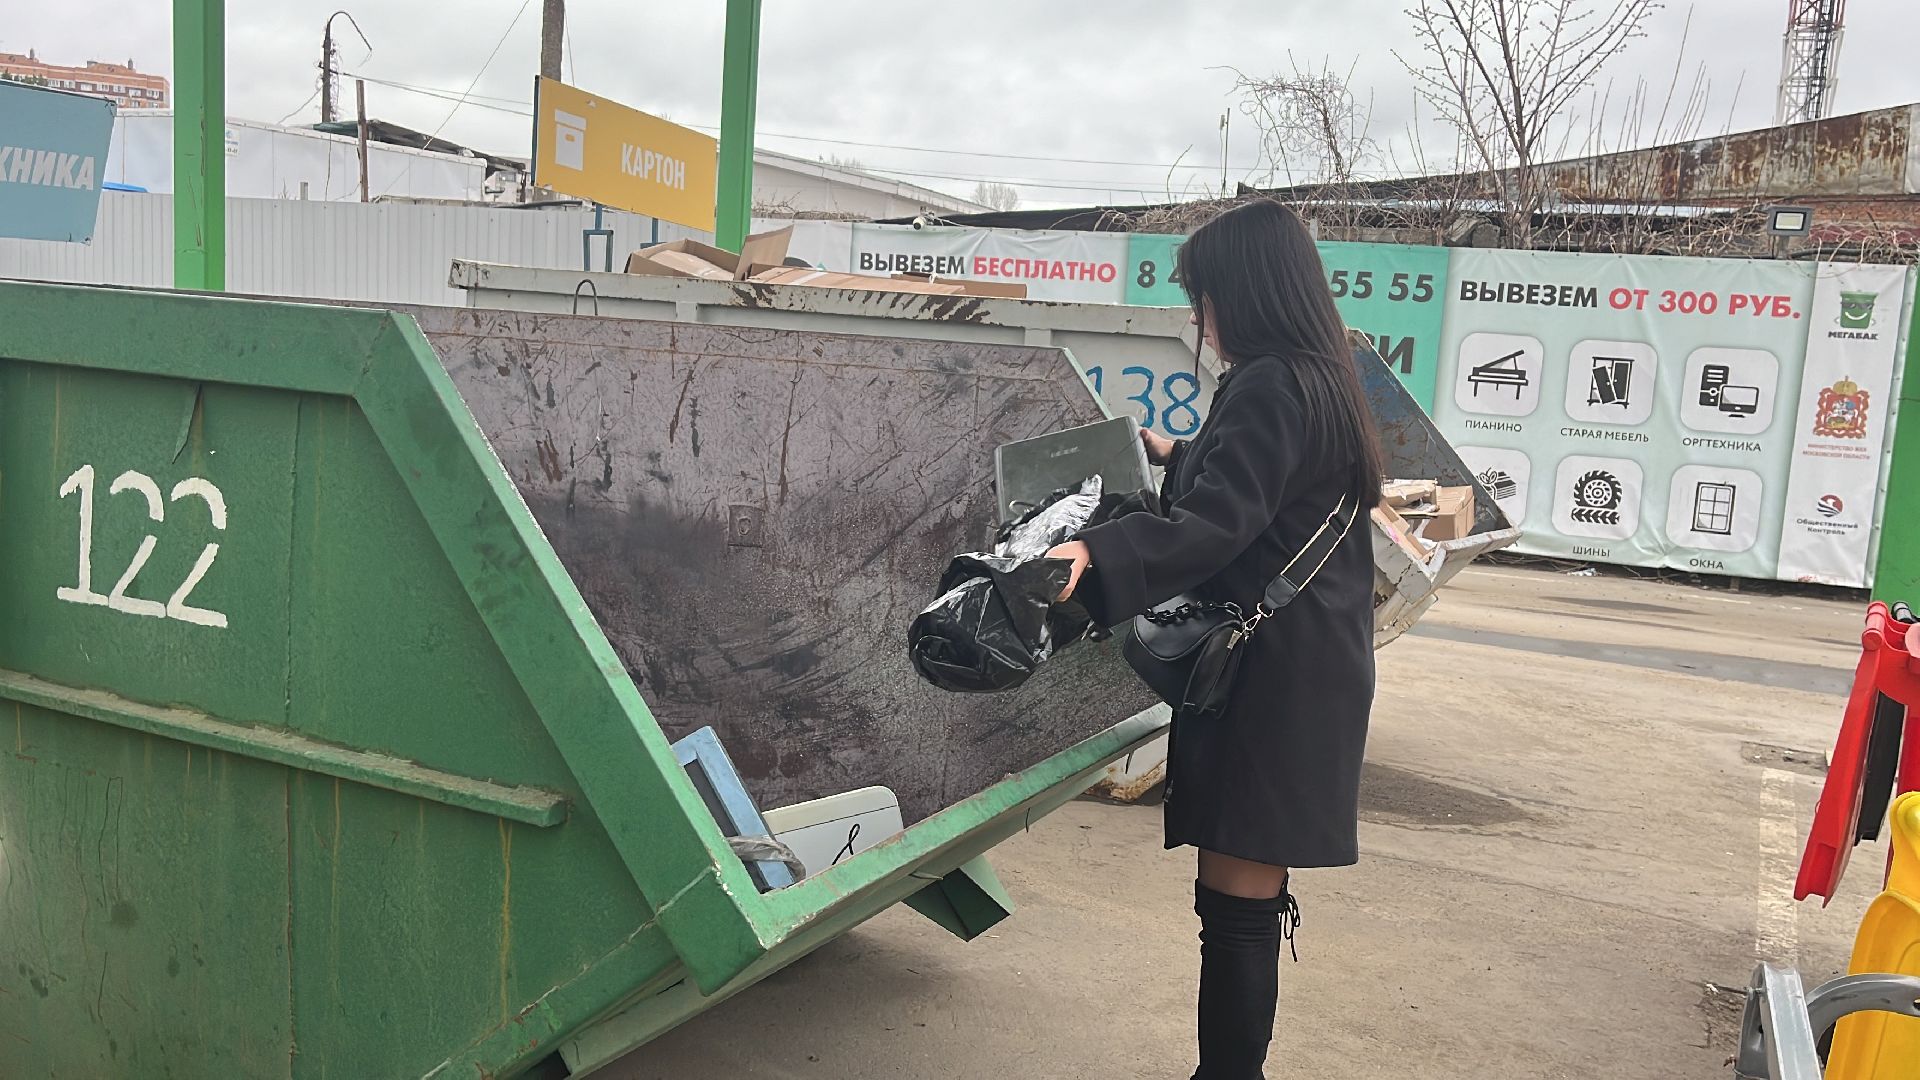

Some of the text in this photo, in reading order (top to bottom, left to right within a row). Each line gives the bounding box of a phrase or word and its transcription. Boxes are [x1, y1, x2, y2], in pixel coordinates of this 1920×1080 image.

[621, 143, 686, 190] КАРТОН
[859, 252, 1117, 283] ВЫВЕЗЕМ БЕСПЛАТНО
[1136, 260, 1156, 289] 8
[1388, 273, 1434, 302] 55
[1459, 280, 1801, 319] ВЫВЕЗЕМ ОТ 300 РУБ.
[1828, 331, 1879, 340] МЕГАБАК
[1464, 419, 1523, 433] ПИАНИНО
[1560, 427, 1650, 443] СТАРАЯ МЕБЕЛЬ
[1682, 437, 1762, 452] ОРГТЕХНИКА
[57, 464, 228, 629] 122
[1572, 545, 1611, 558] ШИНЫ
[1689, 558, 1725, 571] ОКНА
